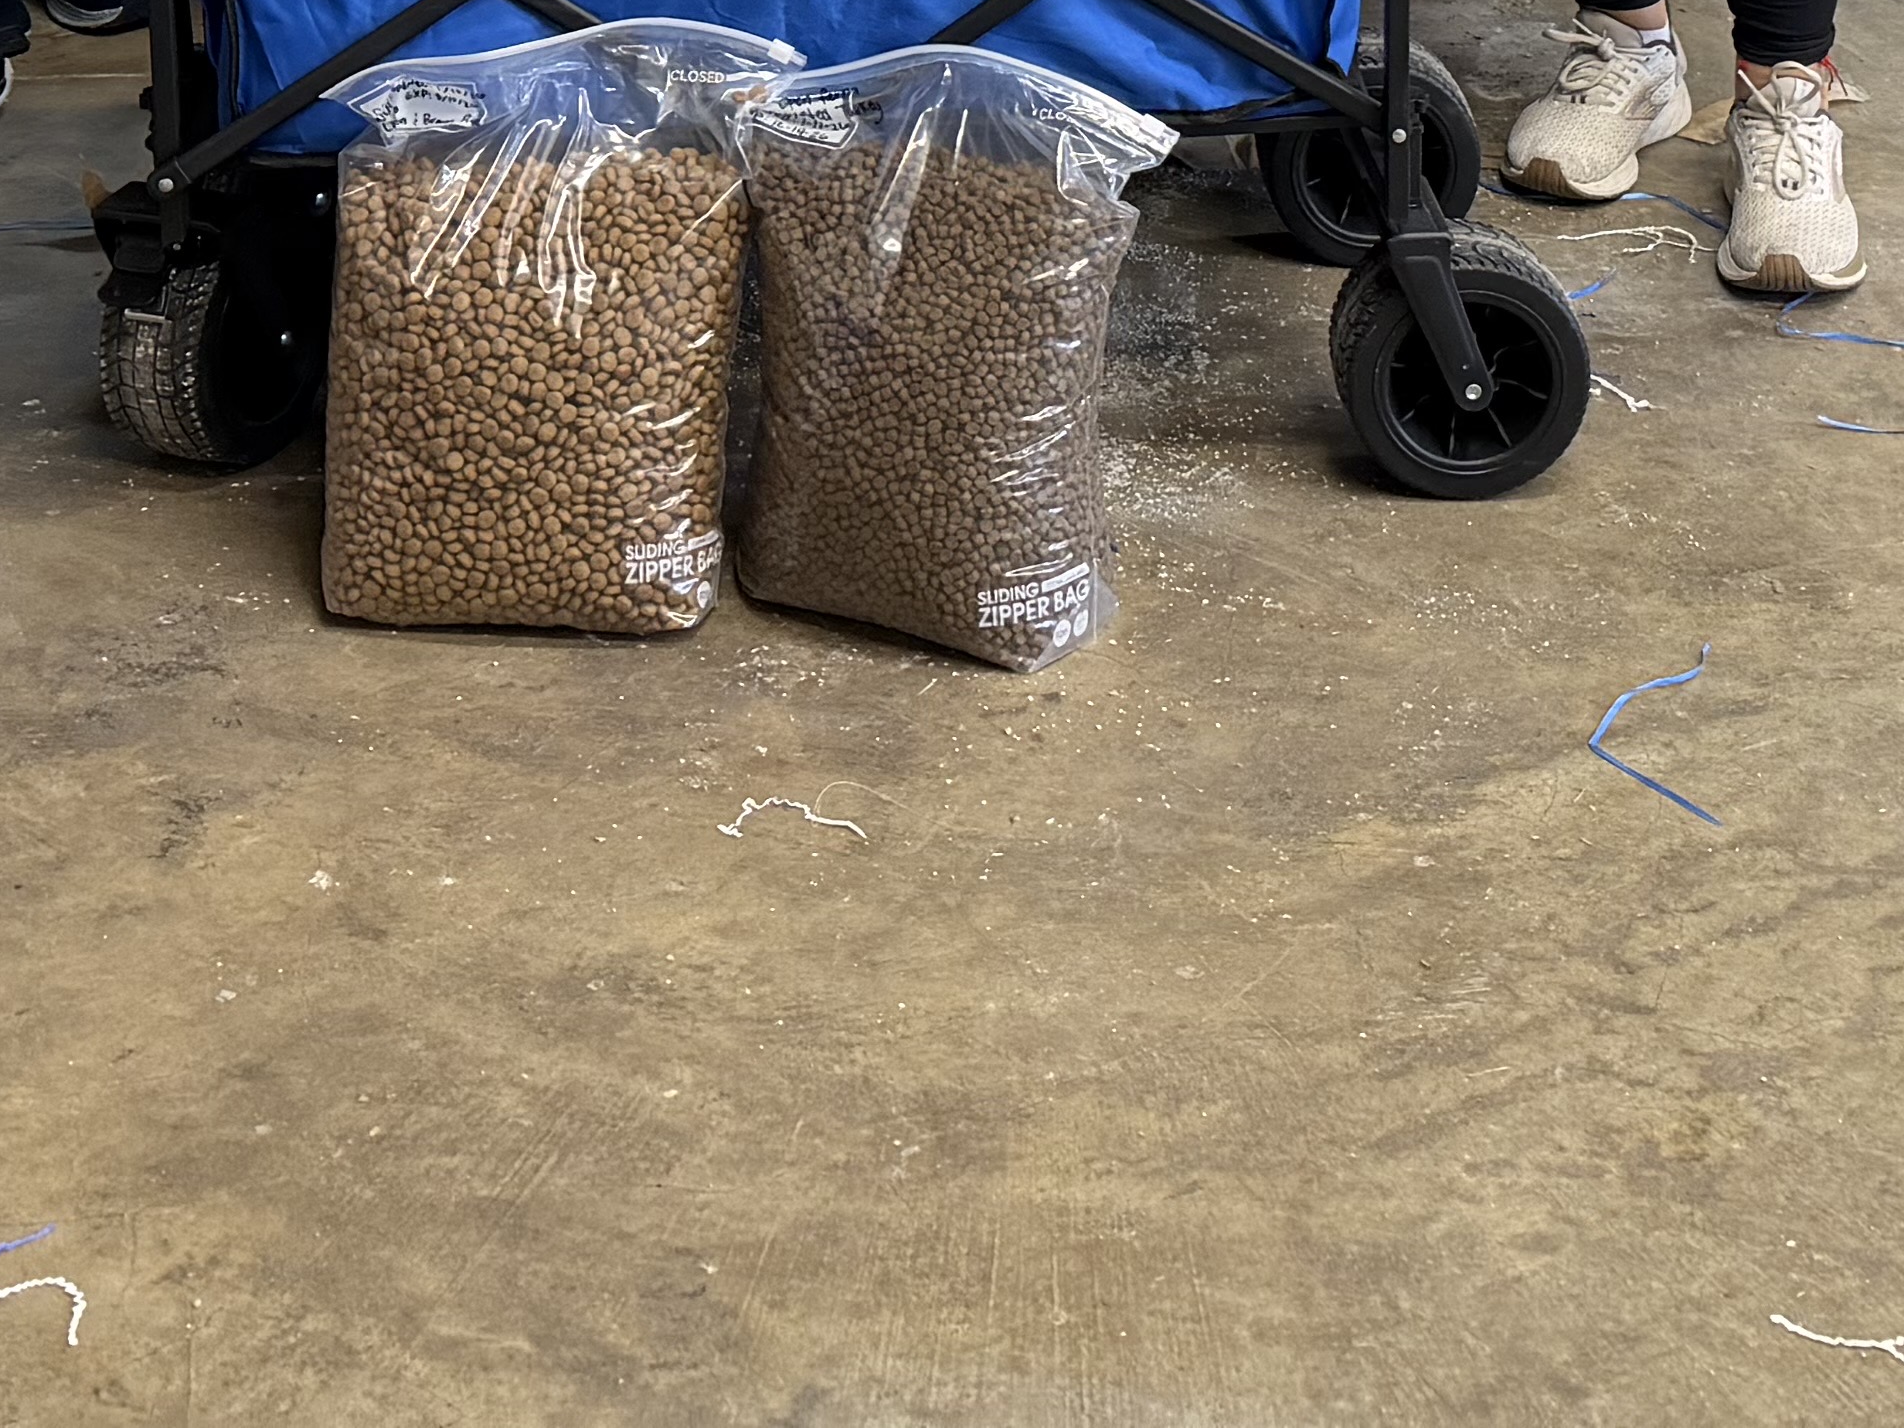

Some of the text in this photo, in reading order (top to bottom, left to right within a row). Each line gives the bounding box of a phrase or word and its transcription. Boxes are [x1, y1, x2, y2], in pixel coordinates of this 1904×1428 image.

[670, 70, 725, 84] CLOSED
[625, 539, 688, 560] SLIDING
[624, 542, 722, 585] ZIPPER BAG
[977, 582, 1040, 606] SLIDING
[978, 578, 1091, 629] ZIPPER BAG
